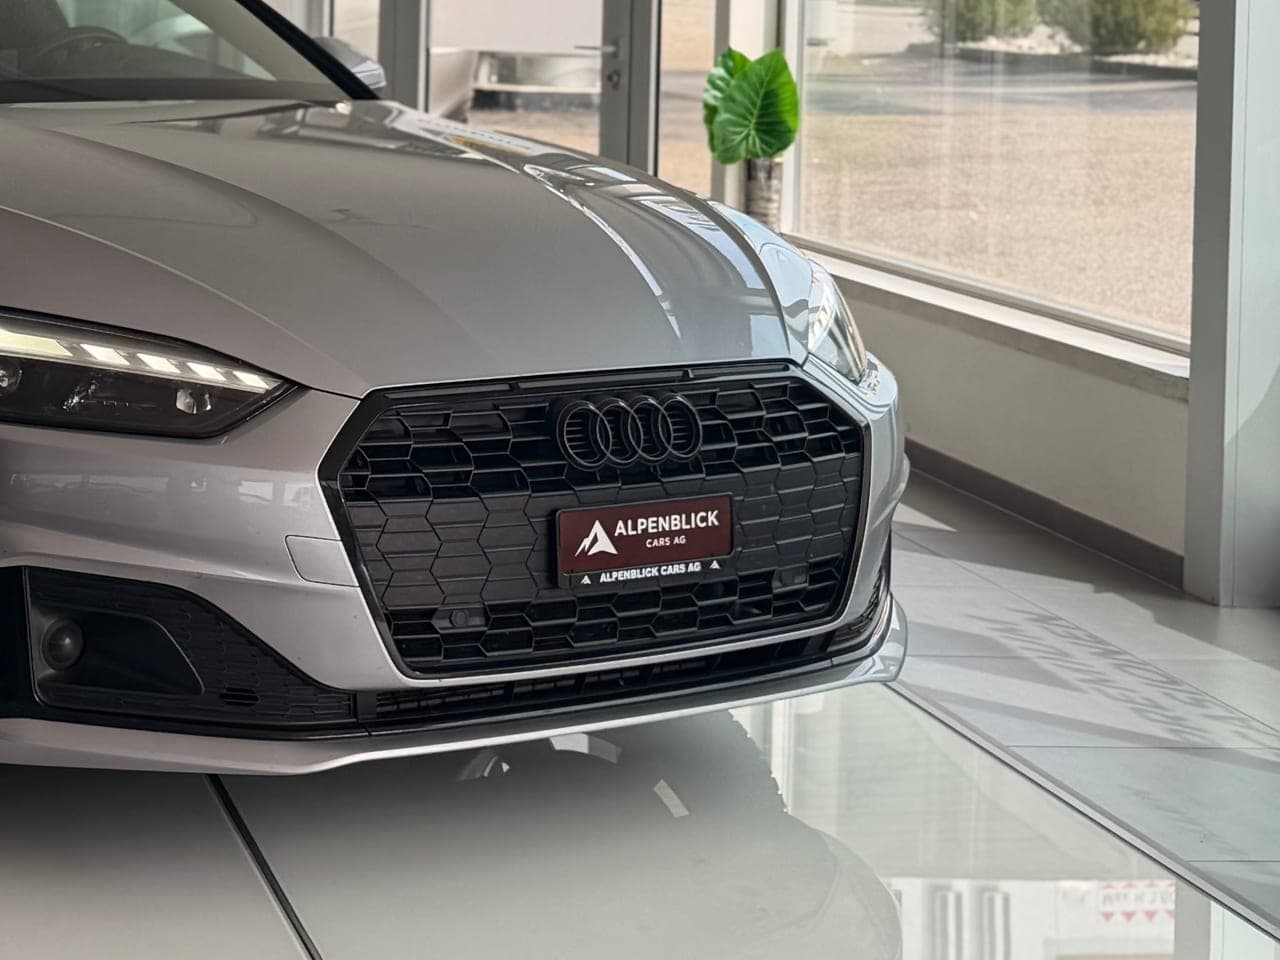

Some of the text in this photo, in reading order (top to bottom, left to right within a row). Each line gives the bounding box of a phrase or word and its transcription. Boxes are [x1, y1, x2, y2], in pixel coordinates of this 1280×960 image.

[614, 510, 719, 536] ALPENBLICK
[646, 535, 686, 548] CARS AG
[600, 561, 701, 583] ALPENBLICK CARS AG
